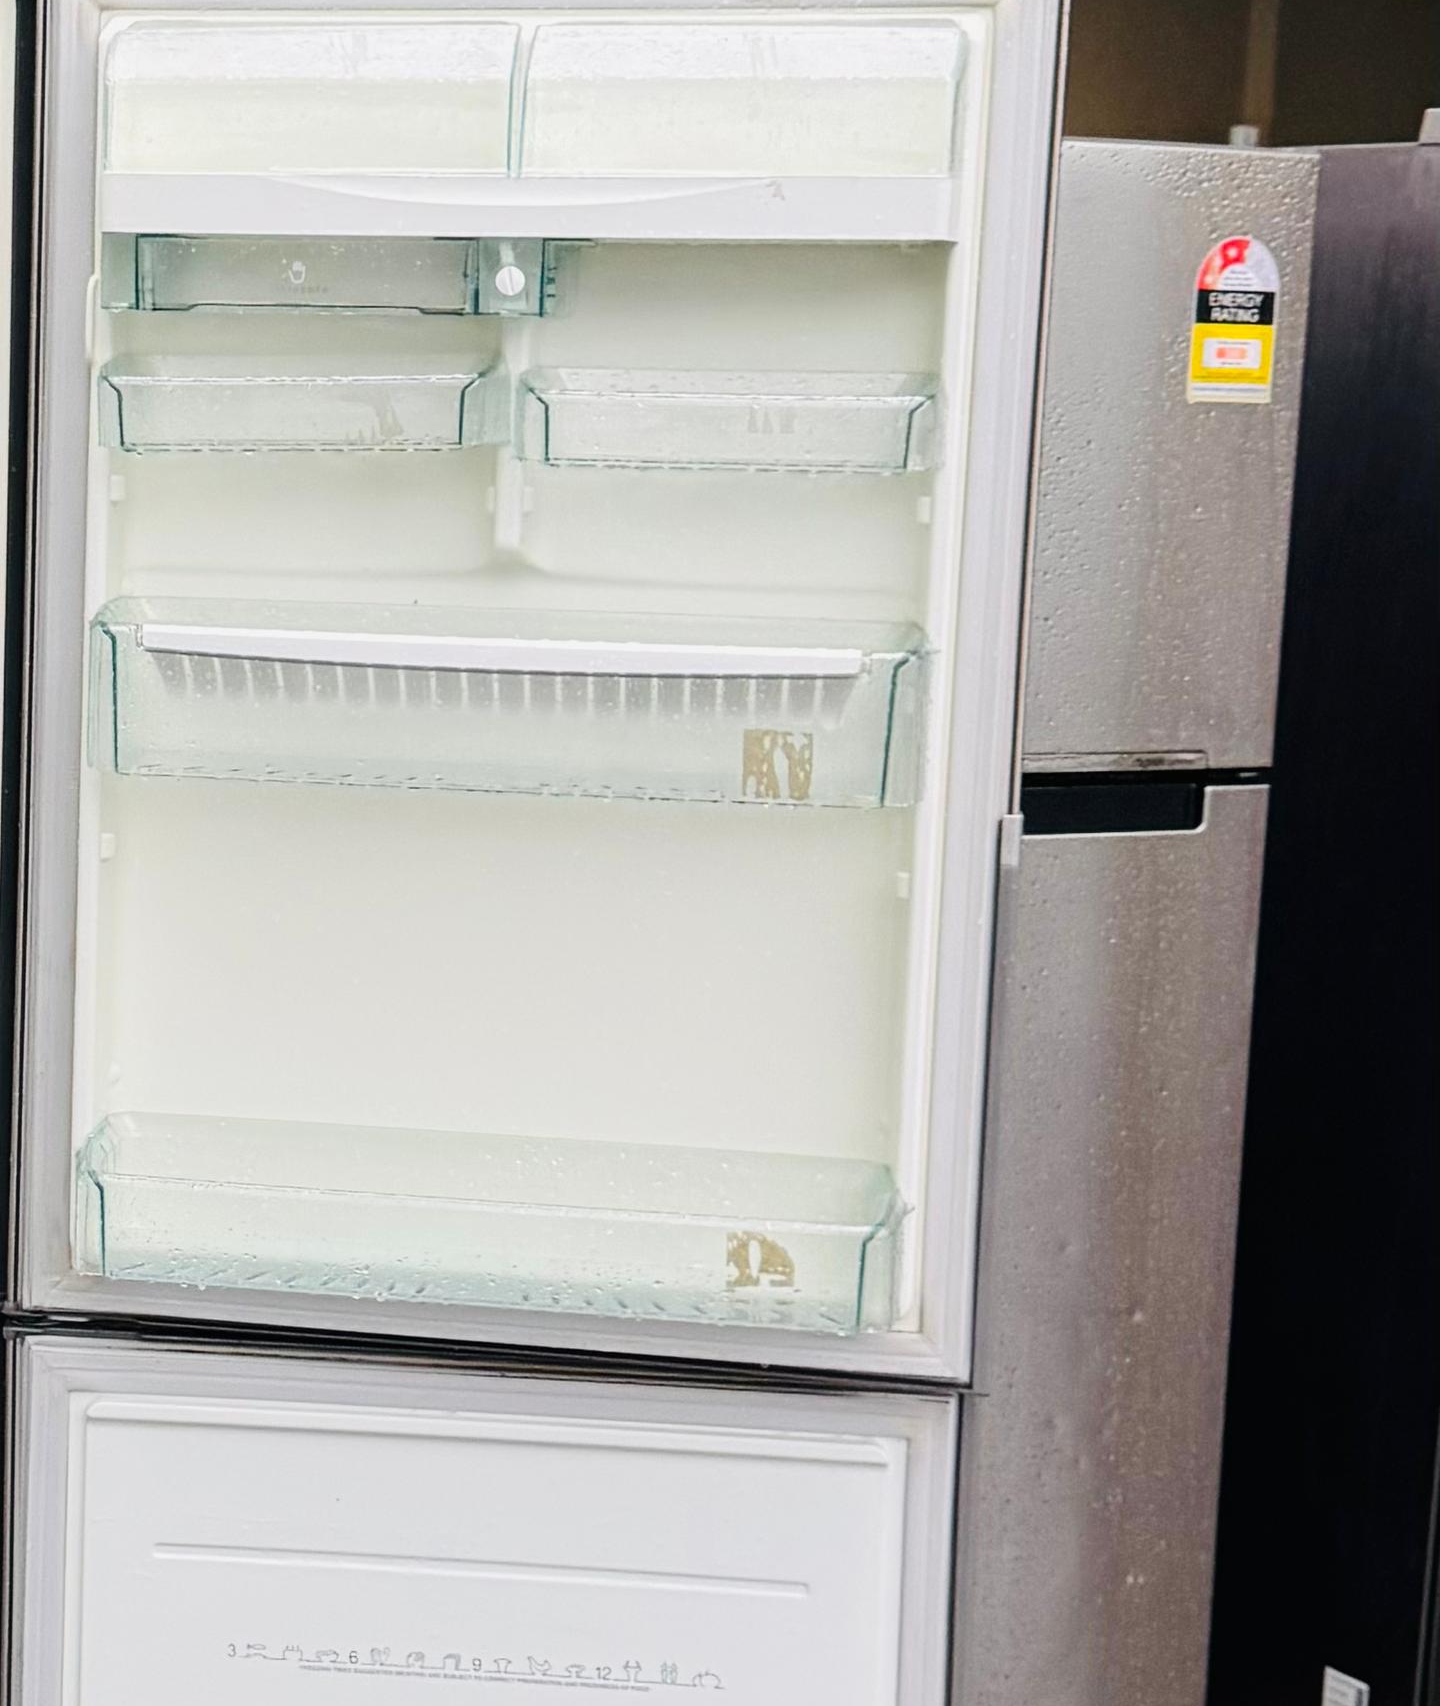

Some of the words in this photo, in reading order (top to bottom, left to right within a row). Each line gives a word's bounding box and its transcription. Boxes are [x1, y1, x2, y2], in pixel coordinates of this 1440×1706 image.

[1208, 292, 1264, 307] ENERGY
[1210, 307, 1260, 323] RATING
[227, 1643, 237, 1658] 3
[348, 1650, 359, 1665] 6
[471, 1658, 482, 1672] 9
[595, 1666, 612, 1680] 12
